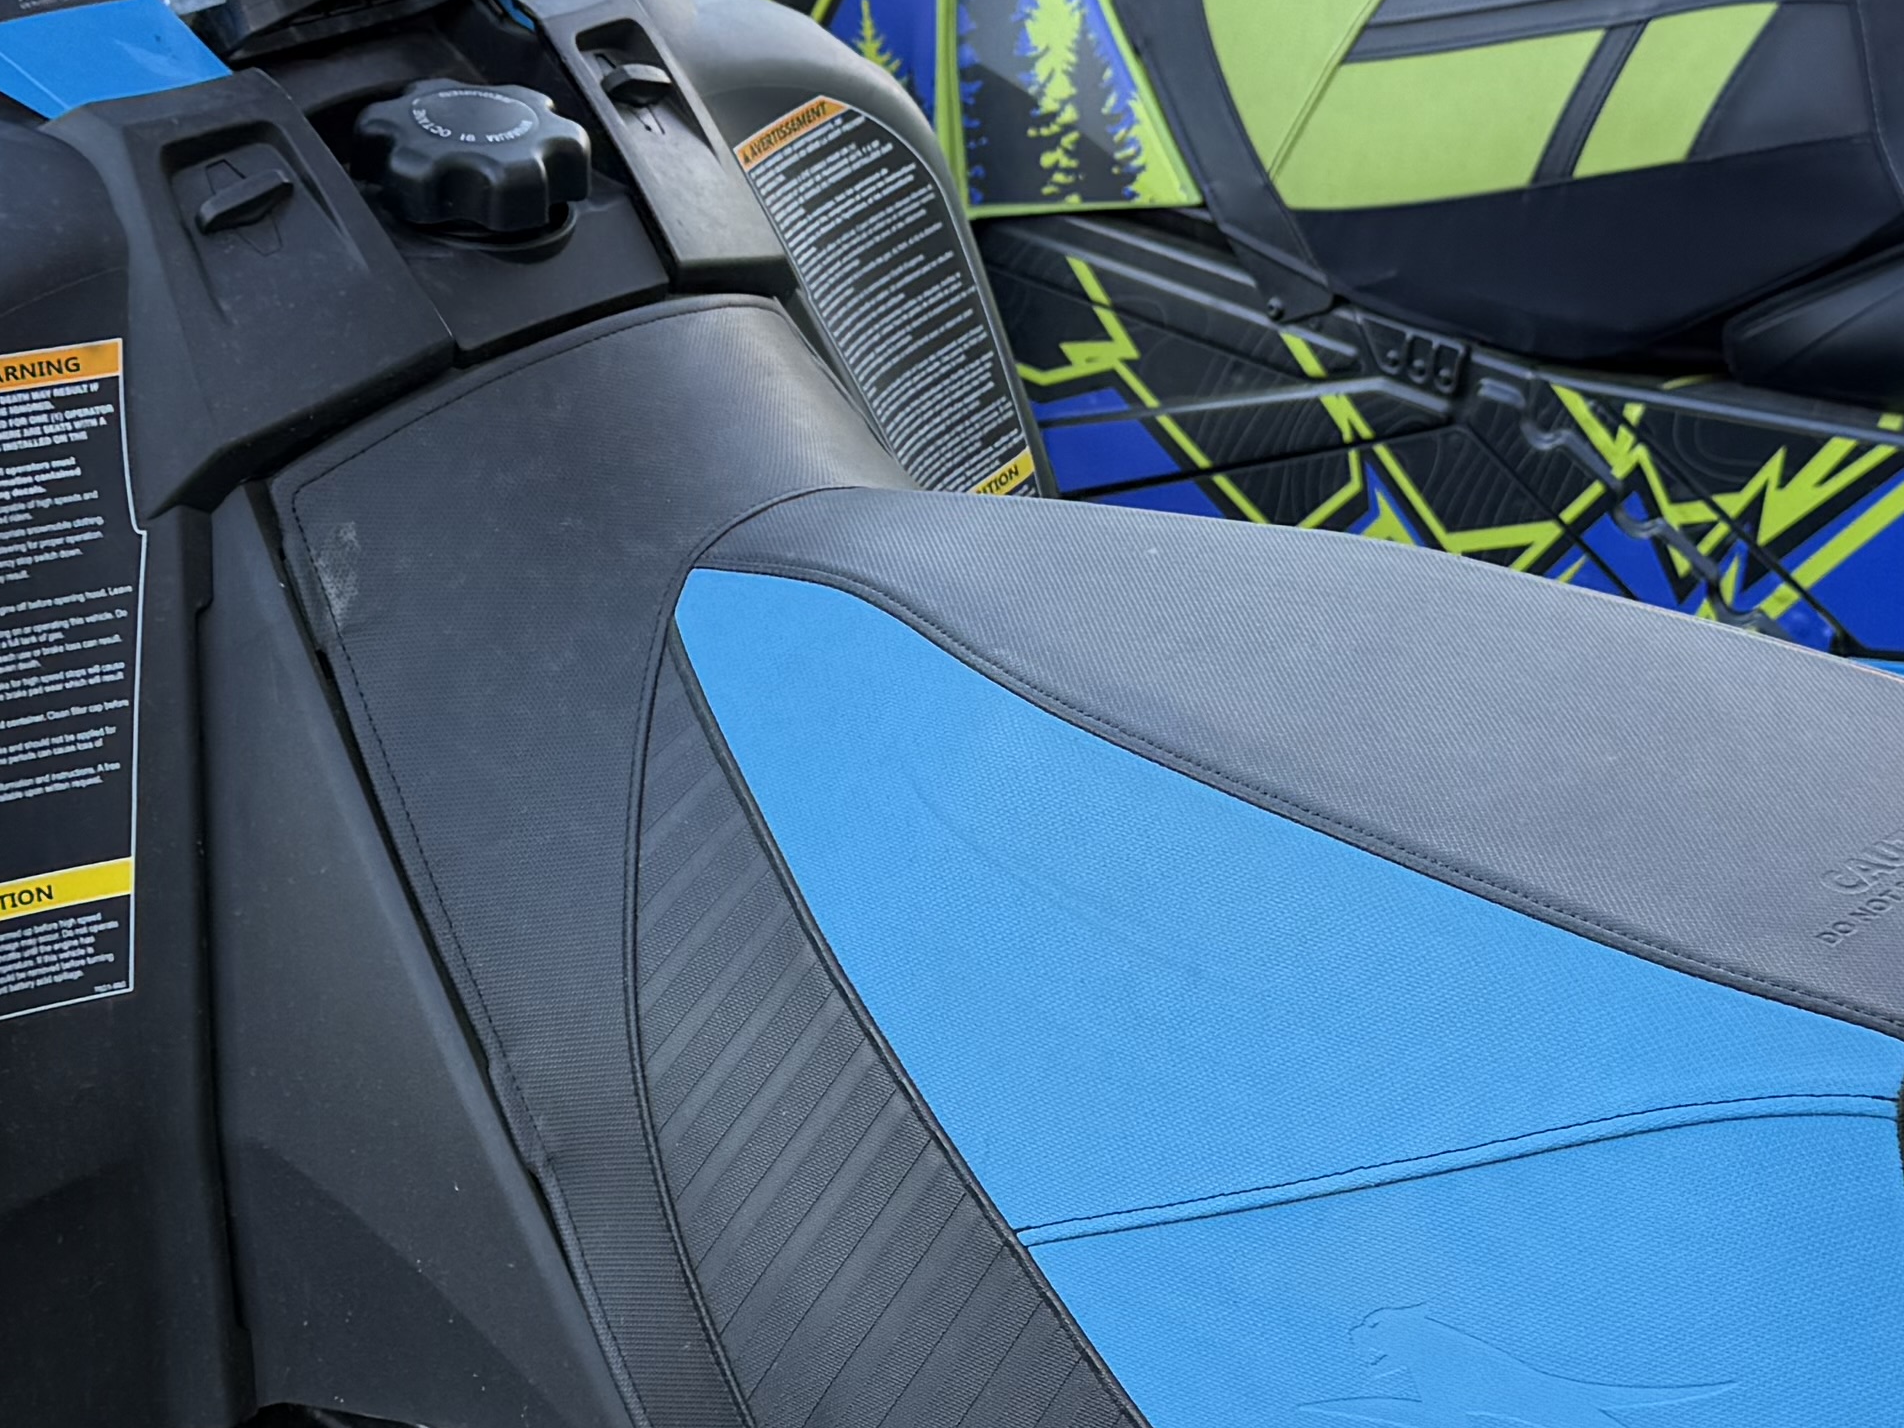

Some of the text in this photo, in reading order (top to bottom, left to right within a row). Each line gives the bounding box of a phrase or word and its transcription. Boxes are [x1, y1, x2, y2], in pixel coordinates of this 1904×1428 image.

[749, 100, 828, 158] AVERTISSEMENT
[1815, 921, 1857, 947] DO
[1849, 889, 1901, 921] NOT
